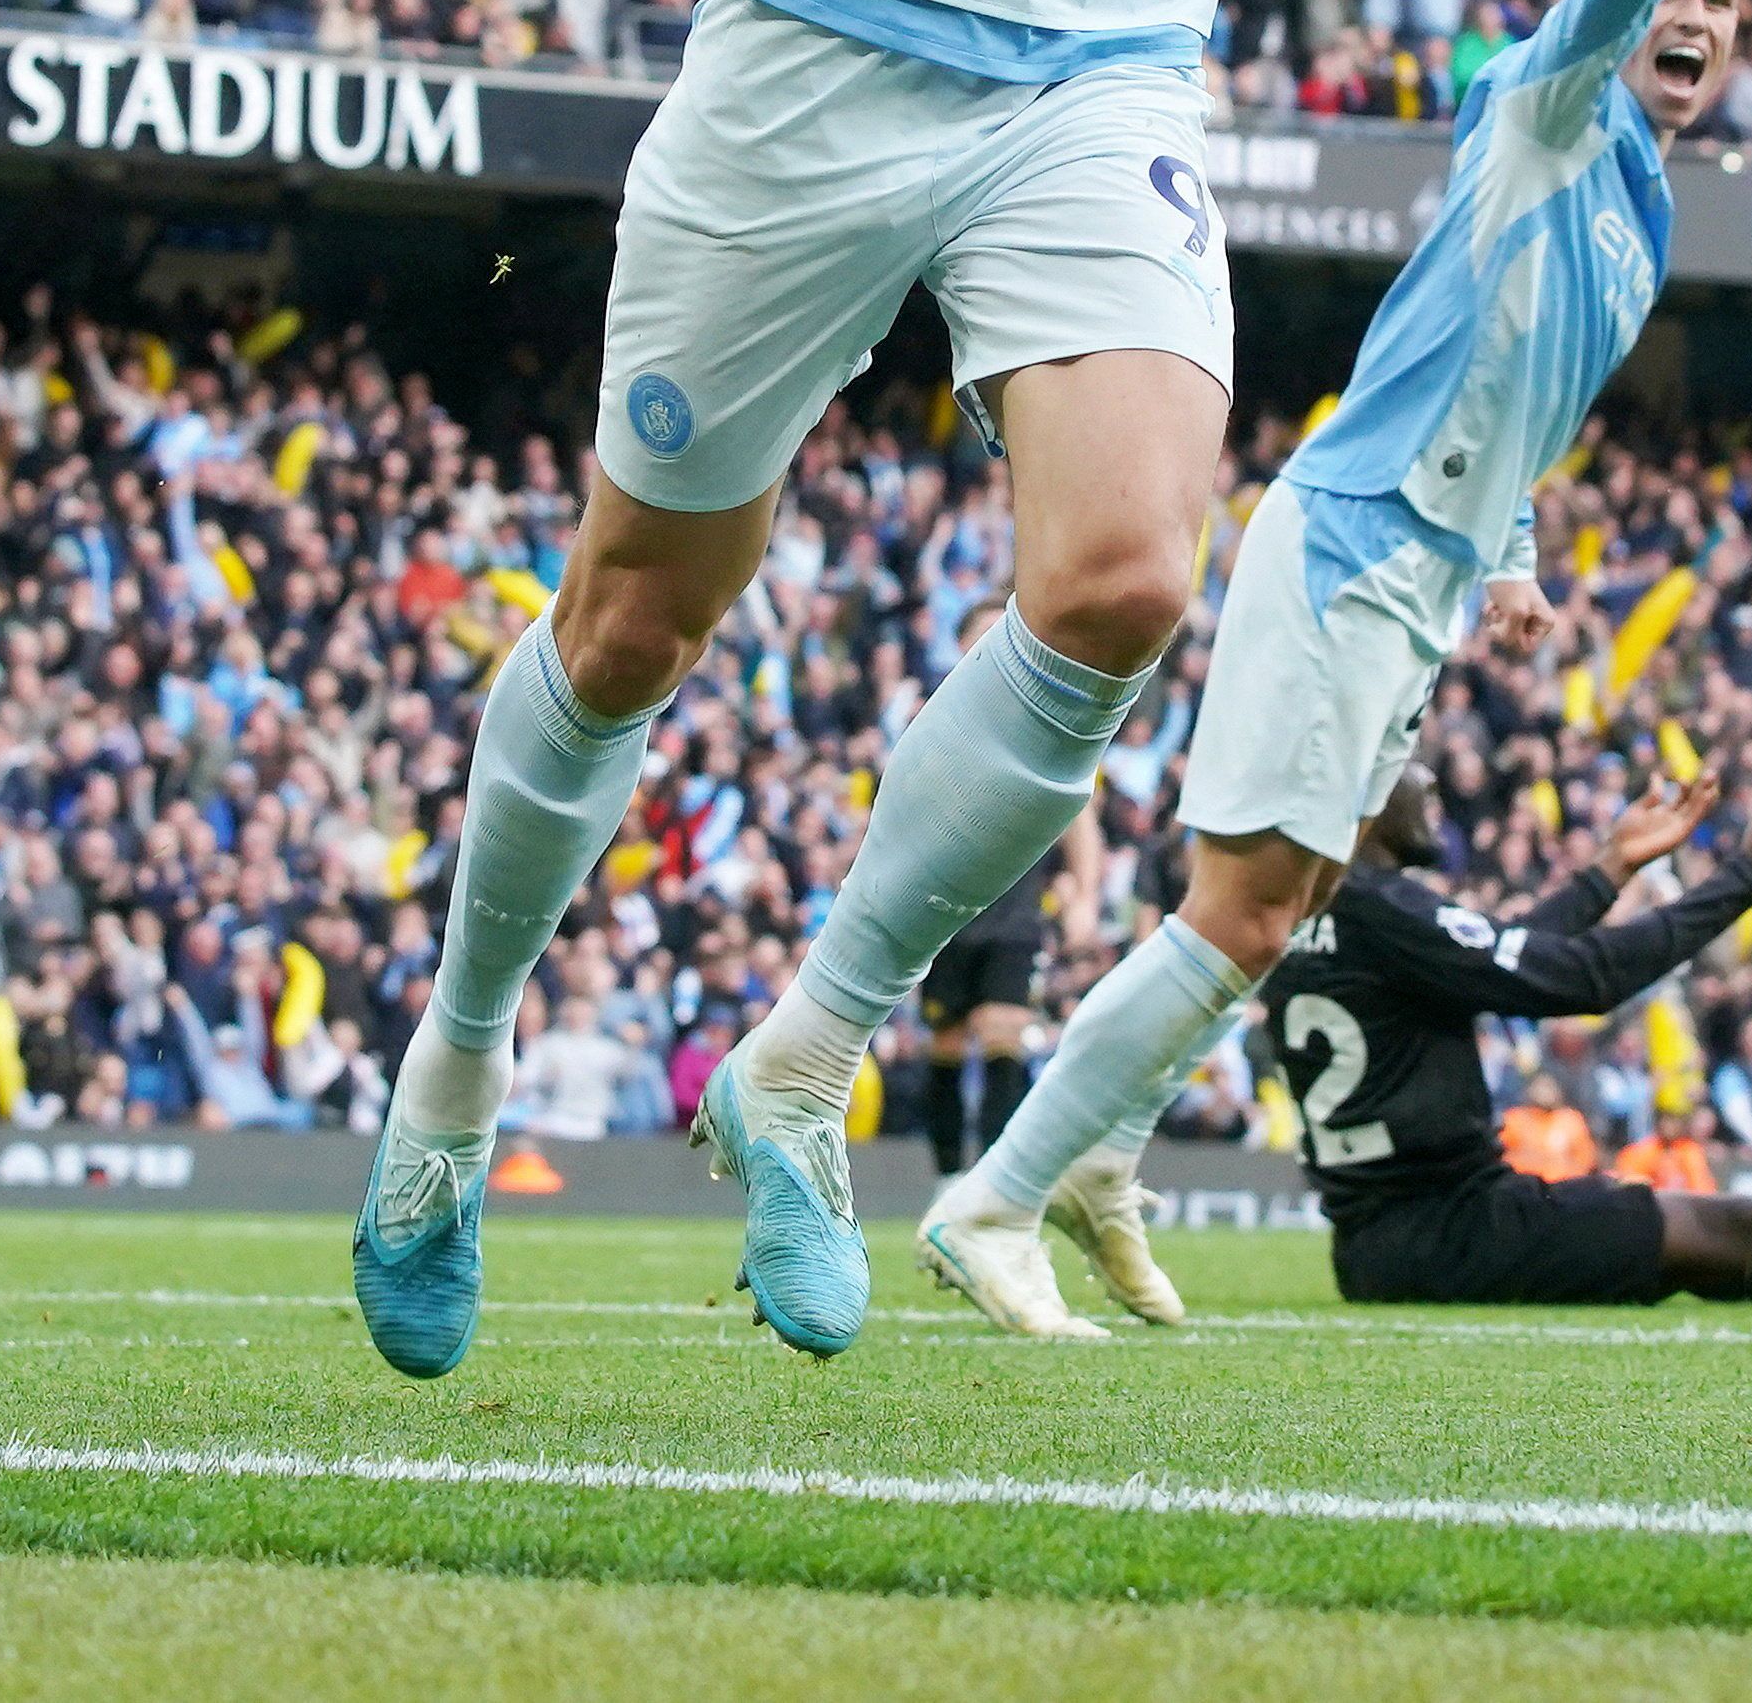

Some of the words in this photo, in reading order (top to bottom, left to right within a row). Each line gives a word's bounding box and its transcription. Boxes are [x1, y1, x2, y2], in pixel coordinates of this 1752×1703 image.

[7, 36, 485, 176] STADIUM
[1149, 155, 1209, 257] 9
[1284, 993, 1396, 1167] 2
